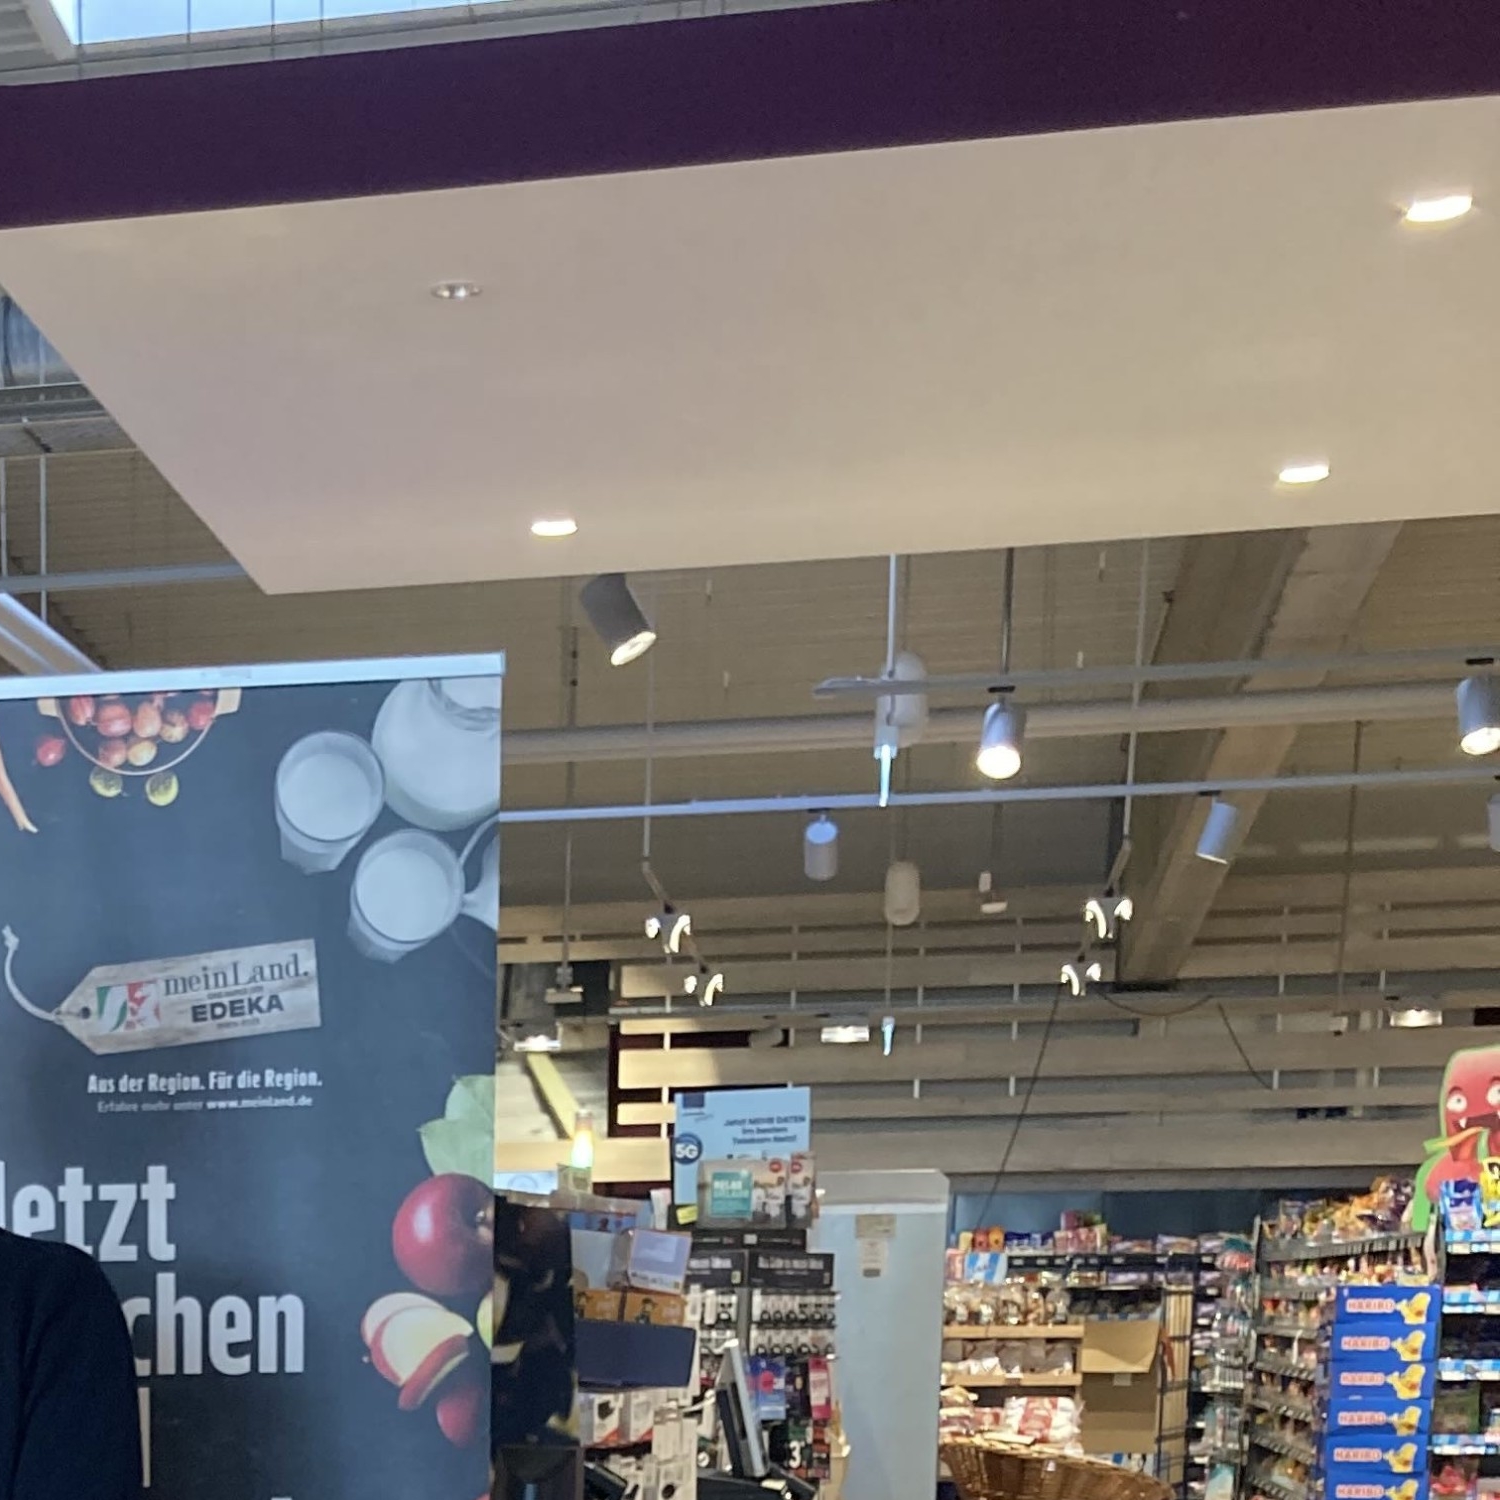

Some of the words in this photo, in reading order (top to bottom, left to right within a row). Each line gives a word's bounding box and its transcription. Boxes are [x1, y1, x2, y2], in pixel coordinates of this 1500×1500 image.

[191, 994, 285, 1023] EDEKA
[87, 1074, 115, 1094] Aus
[118, 1074, 144, 1093] der
[148, 1072, 206, 1095] Region.
[208, 1071, 234, 1090] Für
[237, 1070, 261, 1088] die
[264, 1068, 323, 1091] Region.
[675, 1143, 698, 1159] 5G
[1346, 1298, 1395, 1313] HARIBO
[1334, 1447, 1382, 1462] HARIBO
[1336, 1484, 1384, 1499] HARIBO
